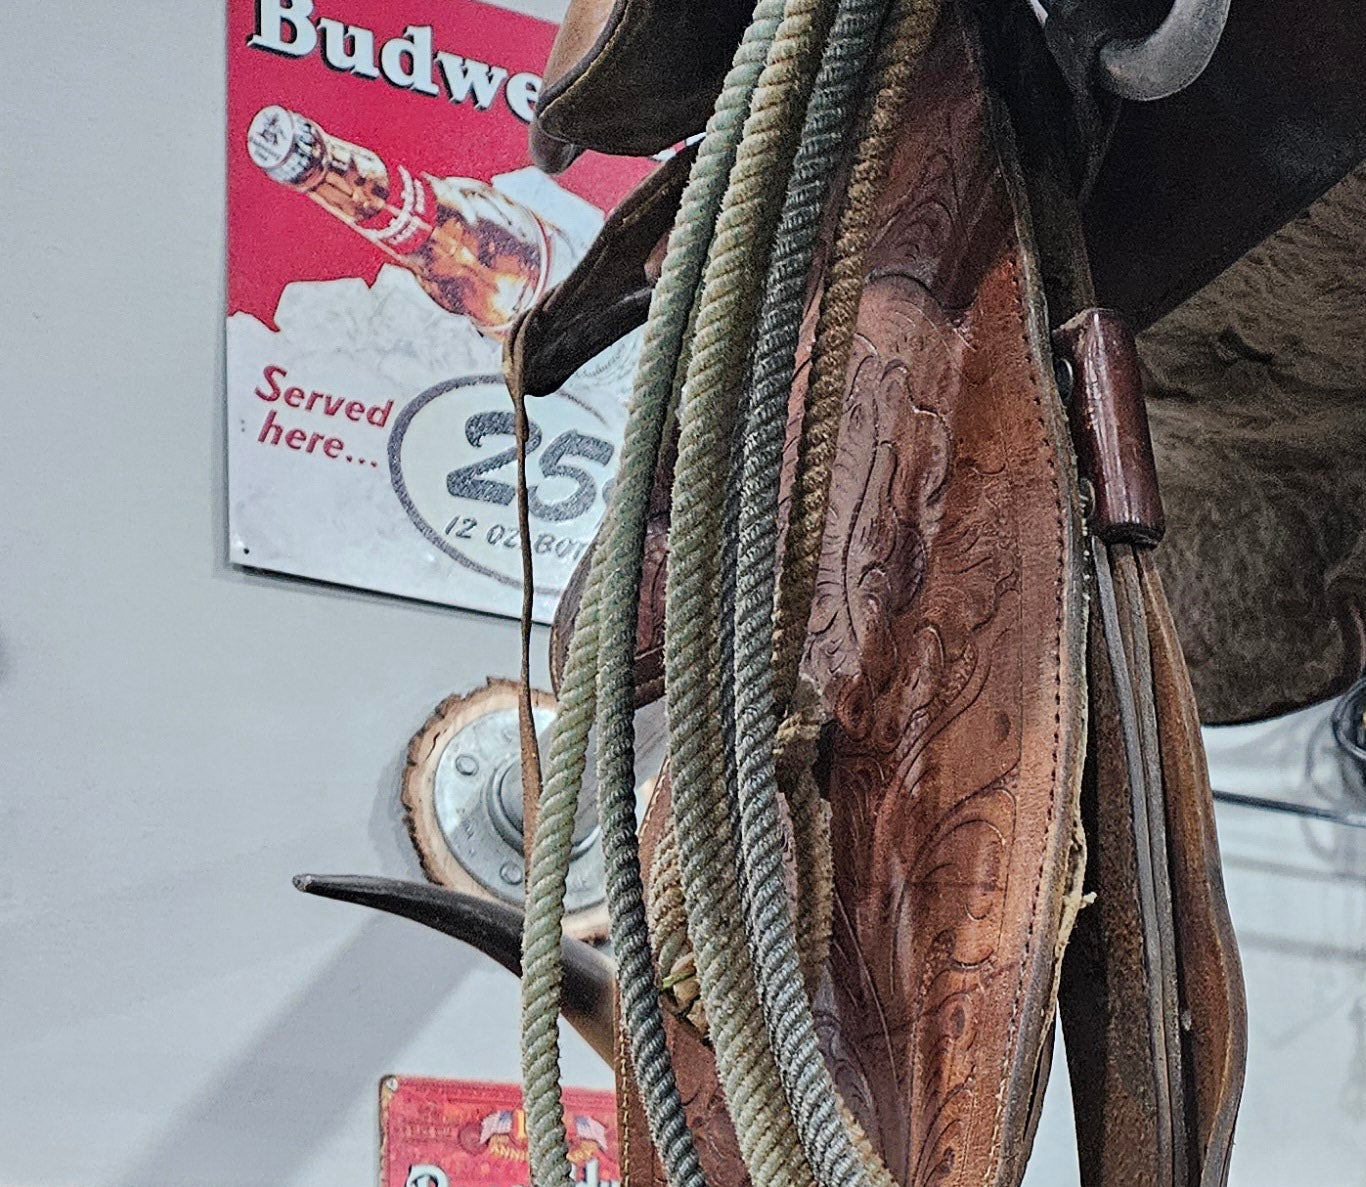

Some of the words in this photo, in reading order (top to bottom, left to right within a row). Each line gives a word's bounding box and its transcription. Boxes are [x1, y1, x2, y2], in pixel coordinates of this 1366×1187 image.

[254, 364, 395, 428] Served
[257, 408, 378, 459] here...
[444, 516, 478, 540] 12
